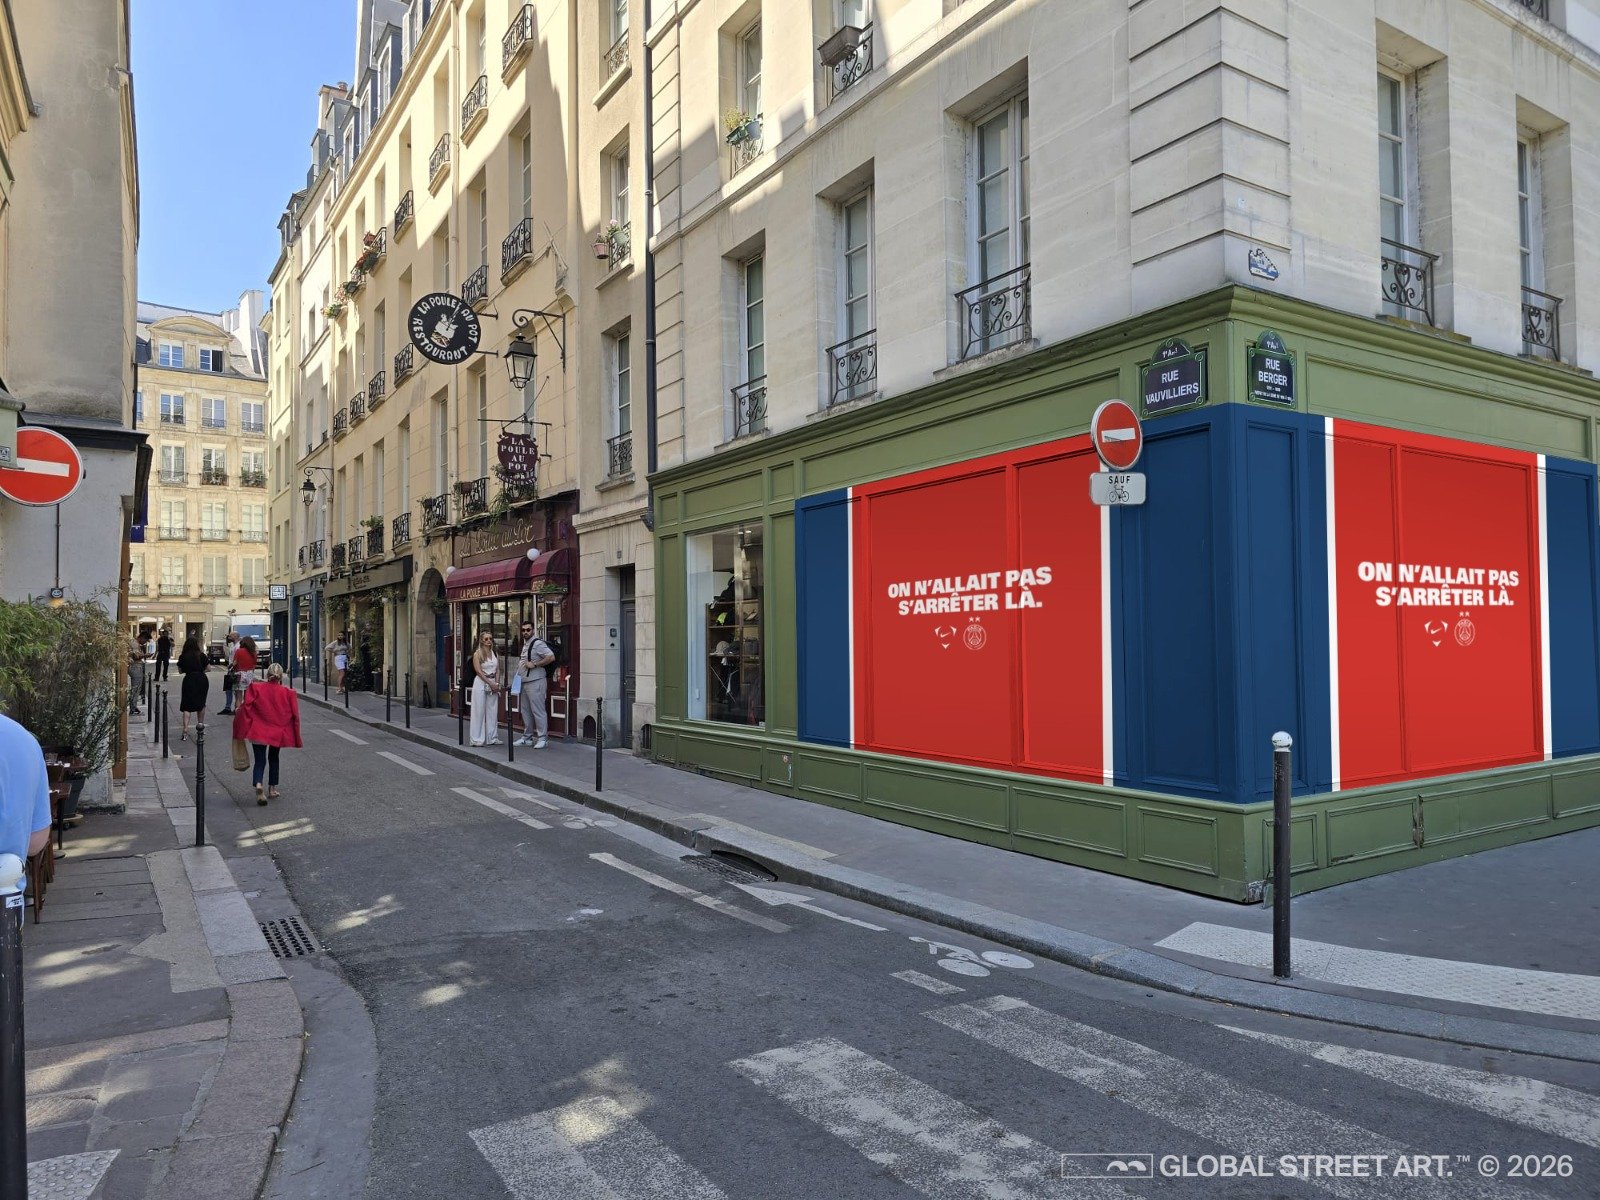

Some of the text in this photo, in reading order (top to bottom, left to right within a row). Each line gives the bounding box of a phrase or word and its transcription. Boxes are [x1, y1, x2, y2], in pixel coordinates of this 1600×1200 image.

[417, 296, 479, 344] LA POULE AU POT
[412, 317, 468, 361] RESTAURANT
[1265, 358, 1280, 371] RUE
[1161, 370, 1179, 384] RUE
[1258, 370, 1288, 387] BERGER
[1145, 382, 1199, 405] VAUVILLIERS
[511, 437, 525, 446] LA
[501, 445, 535, 455] POULE
[508, 462, 528, 471] POT
[511, 455, 525, 463] AU
[1108, 475, 1131, 484] SAUF
[888, 566, 1052, 598] ON N'ALLAIT PAS
[1358, 561, 1519, 587] ON N'ALLAIT PAS
[460, 583, 500, 599] LA POULE AU POT
[1376, 584, 1514, 606] S'ARRÊTER LÀ.
[898, 586, 1042, 616] S'ARRÊTER LÀ.
